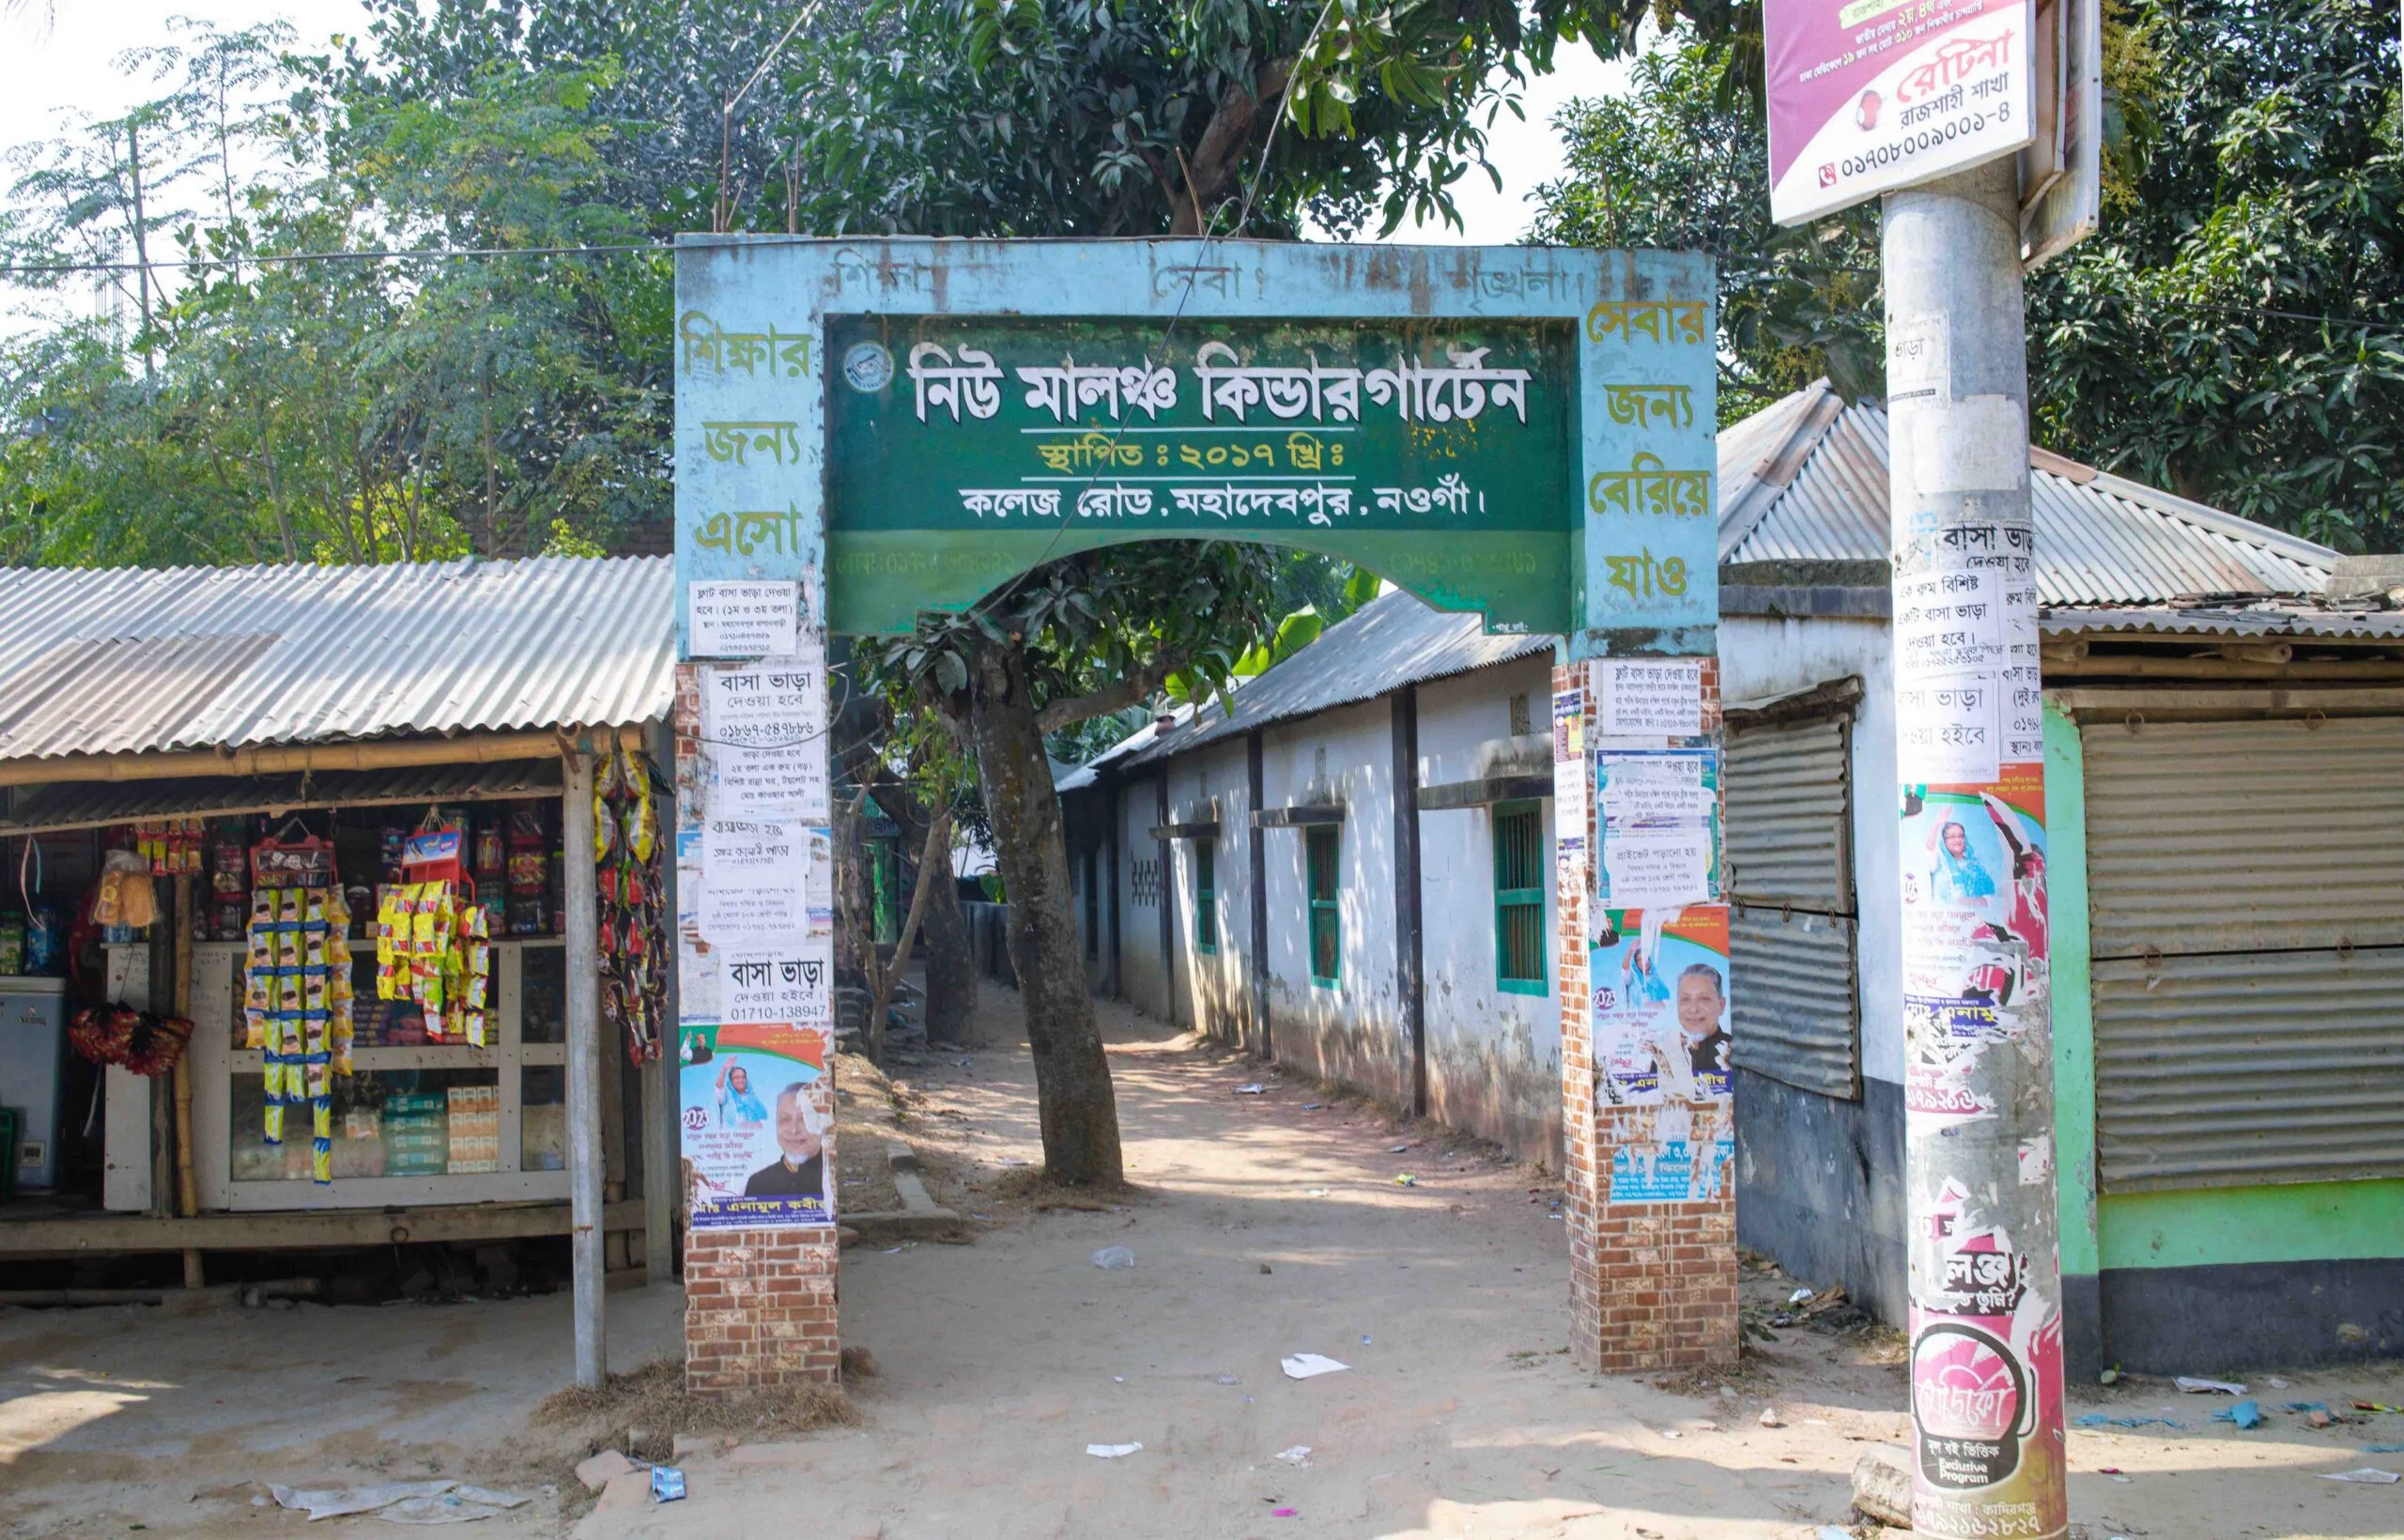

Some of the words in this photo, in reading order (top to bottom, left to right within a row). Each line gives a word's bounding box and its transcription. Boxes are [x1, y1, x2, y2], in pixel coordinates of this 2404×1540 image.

[1878, 36, 1893, 52] মোট
[1894, 30, 1913, 43] ৩১০
[1897, 28, 2016, 103] রেটিনা
[1900, 85, 1964, 130] রাজশাহী
[1971, 72, 2010, 100] শাখা
[1841, 101, 2011, 177] ০১৭০৮০০৯০০১-৪
[1586, 293, 1710, 346] সেবার
[679, 311, 815, 377] শিক্ষার
[1894, 338, 1925, 361] ভাড়া
[906, 341, 1008, 424] নিউ
[1015, 351, 1179, 424] মালঞ্চ
[1193, 341, 1533, 426] কিন্ডারগার্টেন
[1603, 384, 1694, 430] জন্য
[701, 421, 803, 468] জন্য
[1038, 433, 1143, 475] স্থাপিত
[1179, 443, 1275, 470] ২০১৭
[1589, 452, 1711, 516] বেরিয়ে
[958, 488, 1062, 518] কলেজ
[696, 501, 804, 556] এসো
[1940, 524, 1996, 551] বাসা
[1605, 546, 1687, 601] যাও
[1916, 582, 1936, 596] রুম
[1941, 574, 1980, 594] বিশিষ্ট
[718, 587, 737, 598] বাসা
[740, 587, 762, 600] ভাড়া
[764, 587, 791, 598] দেওয়া
[696, 605, 713, 616] হবে
[1925, 607, 1950, 622] বাসা
[1955, 603, 1988, 621] ভাড়া
[1940, 632, 1965, 647] হবে
[718, 673, 763, 692] বাসা
[767, 670, 812, 692] ভাড়া
[1630, 668, 1644, 680] বাসা
[1646, 668, 1662, 683] ভাড়া
[1664, 668, 1685, 681] দেওয়া
[1686, 668, 1699, 681] হবে
[2002, 666, 2024, 683] বাসা
[727, 695, 771, 709] দেওয়া
[776, 693, 805, 706] হবে
[1934, 687, 1983, 712] ভাড়া
[1938, 722, 1986, 747] হইবে
[729, 960, 772, 989] বাসা
[778, 958, 825, 990] ভাড়া
[734, 991, 775, 1004] দেওয়া
[780, 988, 814, 1002] হইবে
[731, 1005, 827, 1021] 01710-138947
[727, 1201, 782, 1214] এনামুল
[1938, 1456, 1988, 1474] Exclusive
[1939, 1470, 1989, 1485] Program
